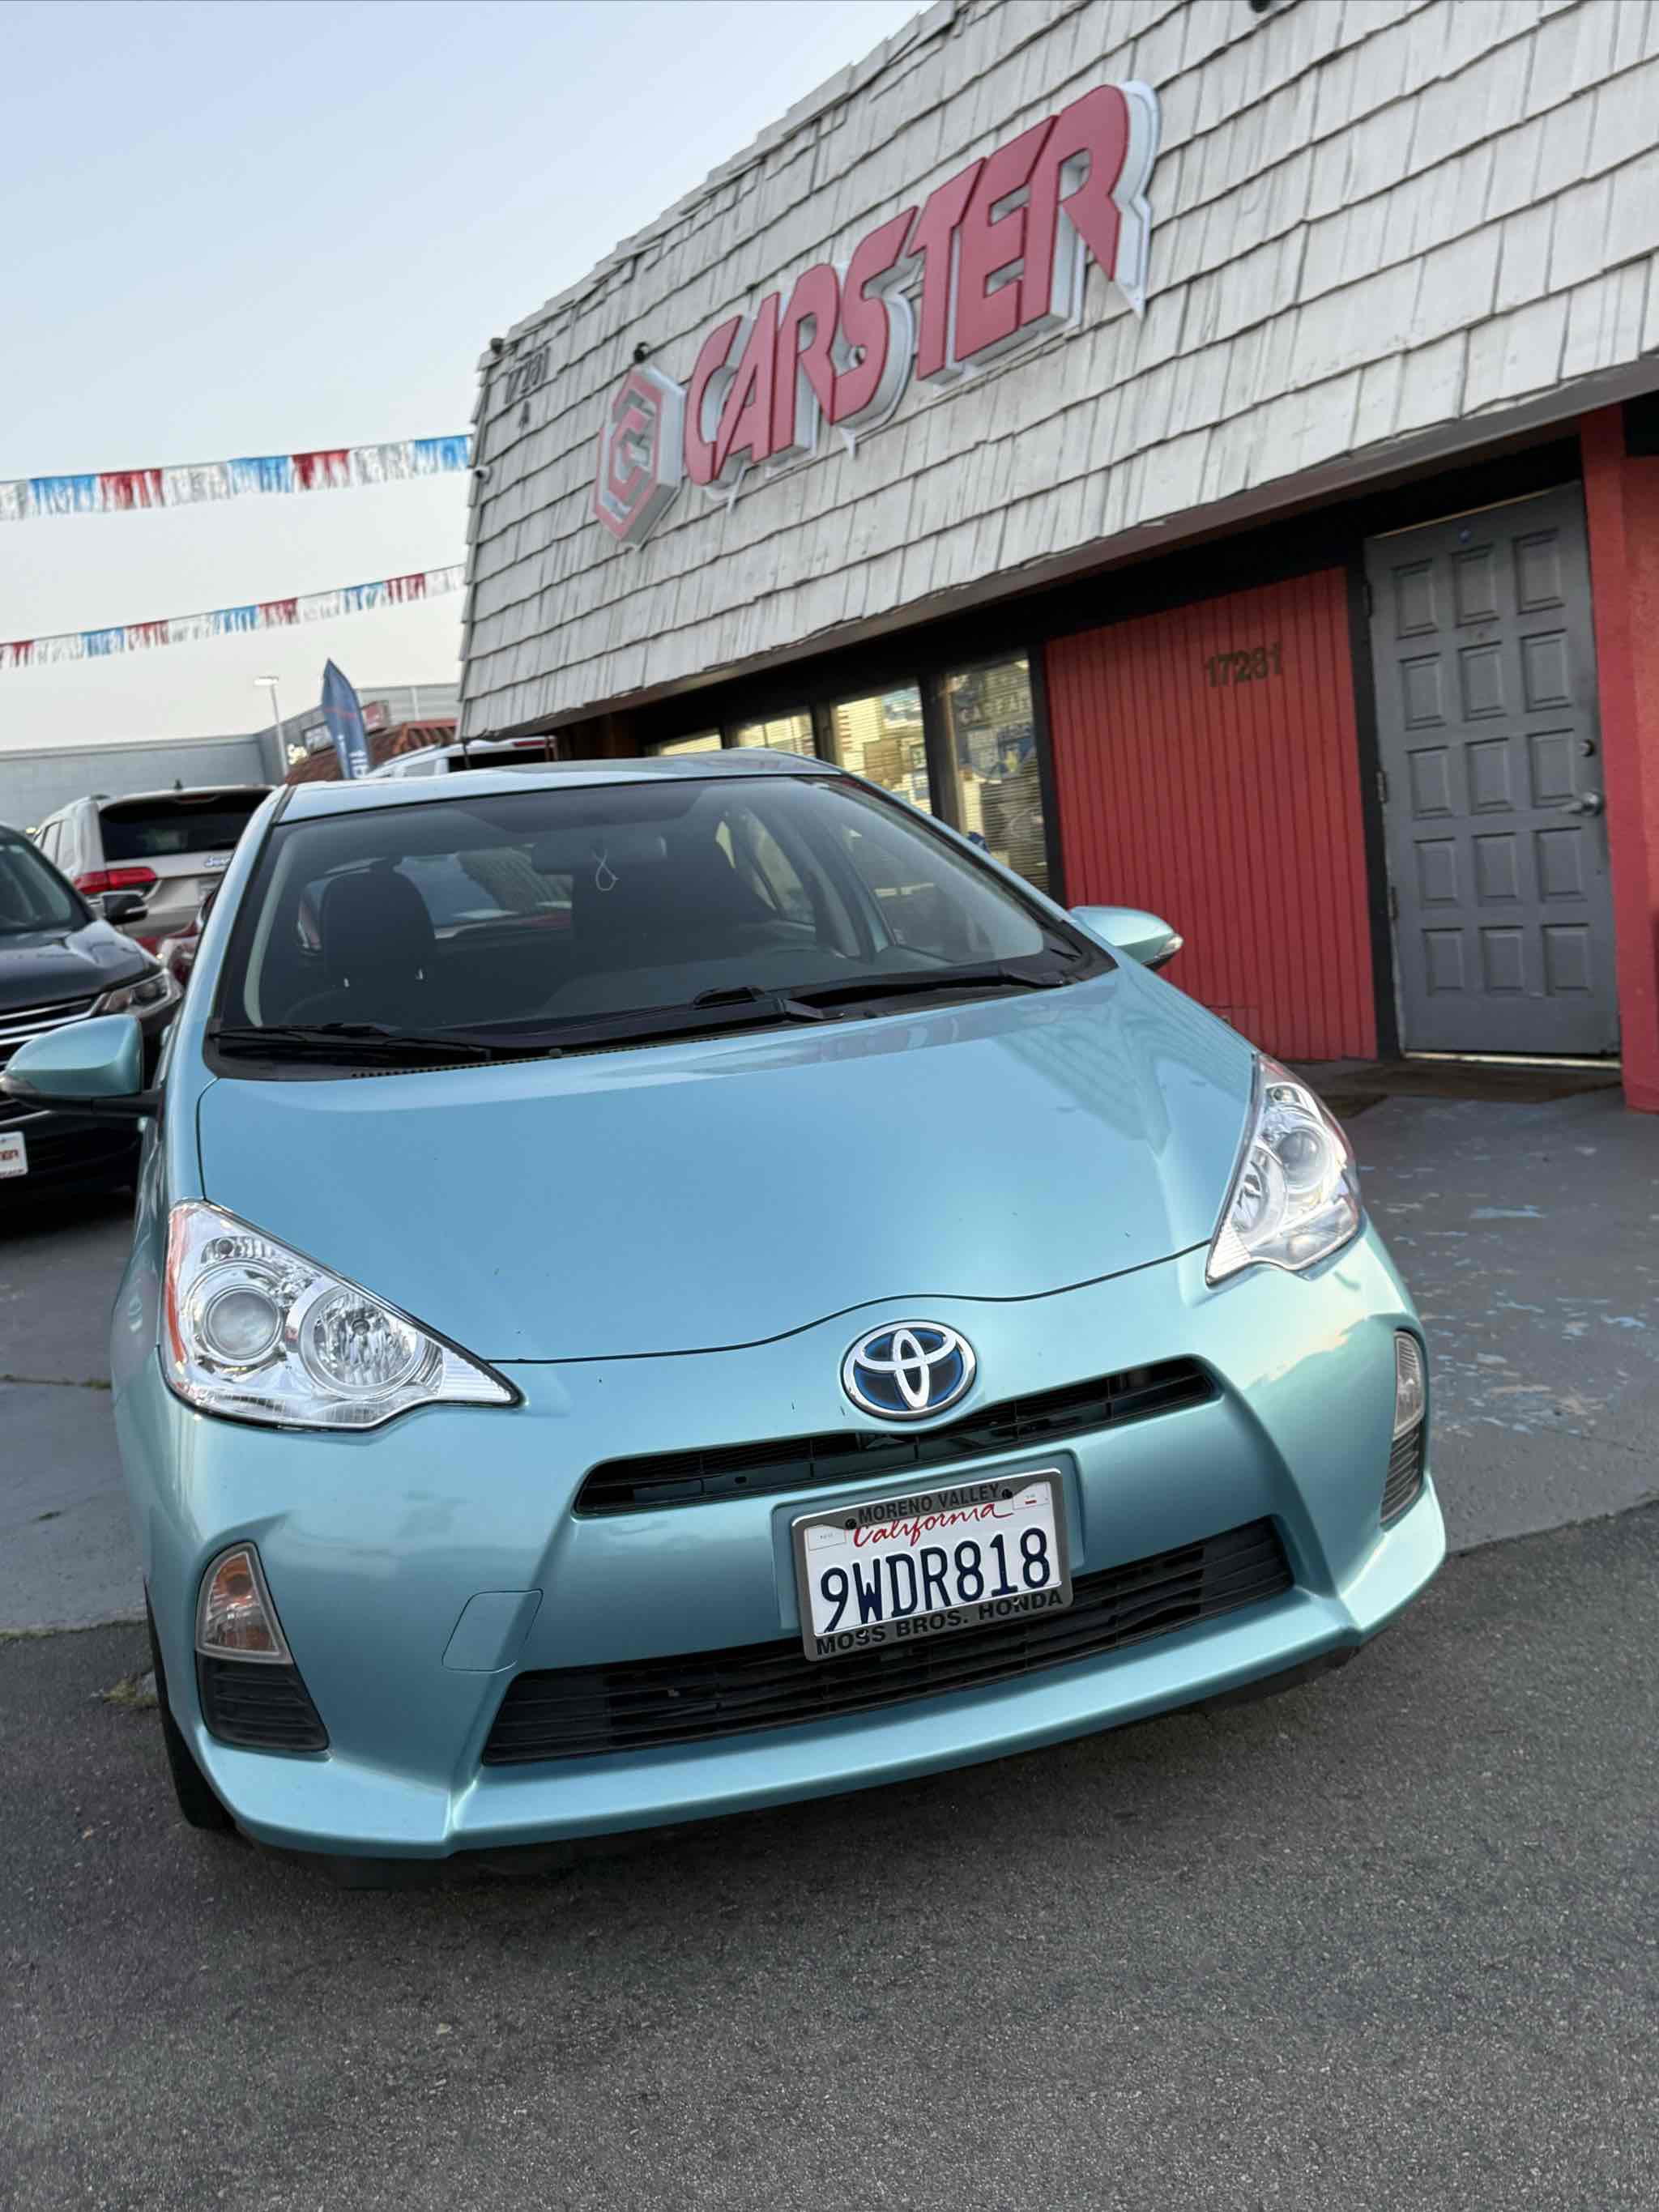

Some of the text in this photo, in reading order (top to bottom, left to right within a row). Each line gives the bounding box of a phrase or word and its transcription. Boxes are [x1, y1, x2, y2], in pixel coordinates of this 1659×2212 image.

[684, 84, 1131, 487] CARSTER
[1208, 641, 1283, 688] 17281
[852, 1502, 1014, 1548] California
[858, 1482, 1001, 1524] MORENO VALLEY
[820, 1527, 1051, 1634] 9WDR818
[816, 1590, 1064, 1655] MOSS BROS. HONDA
